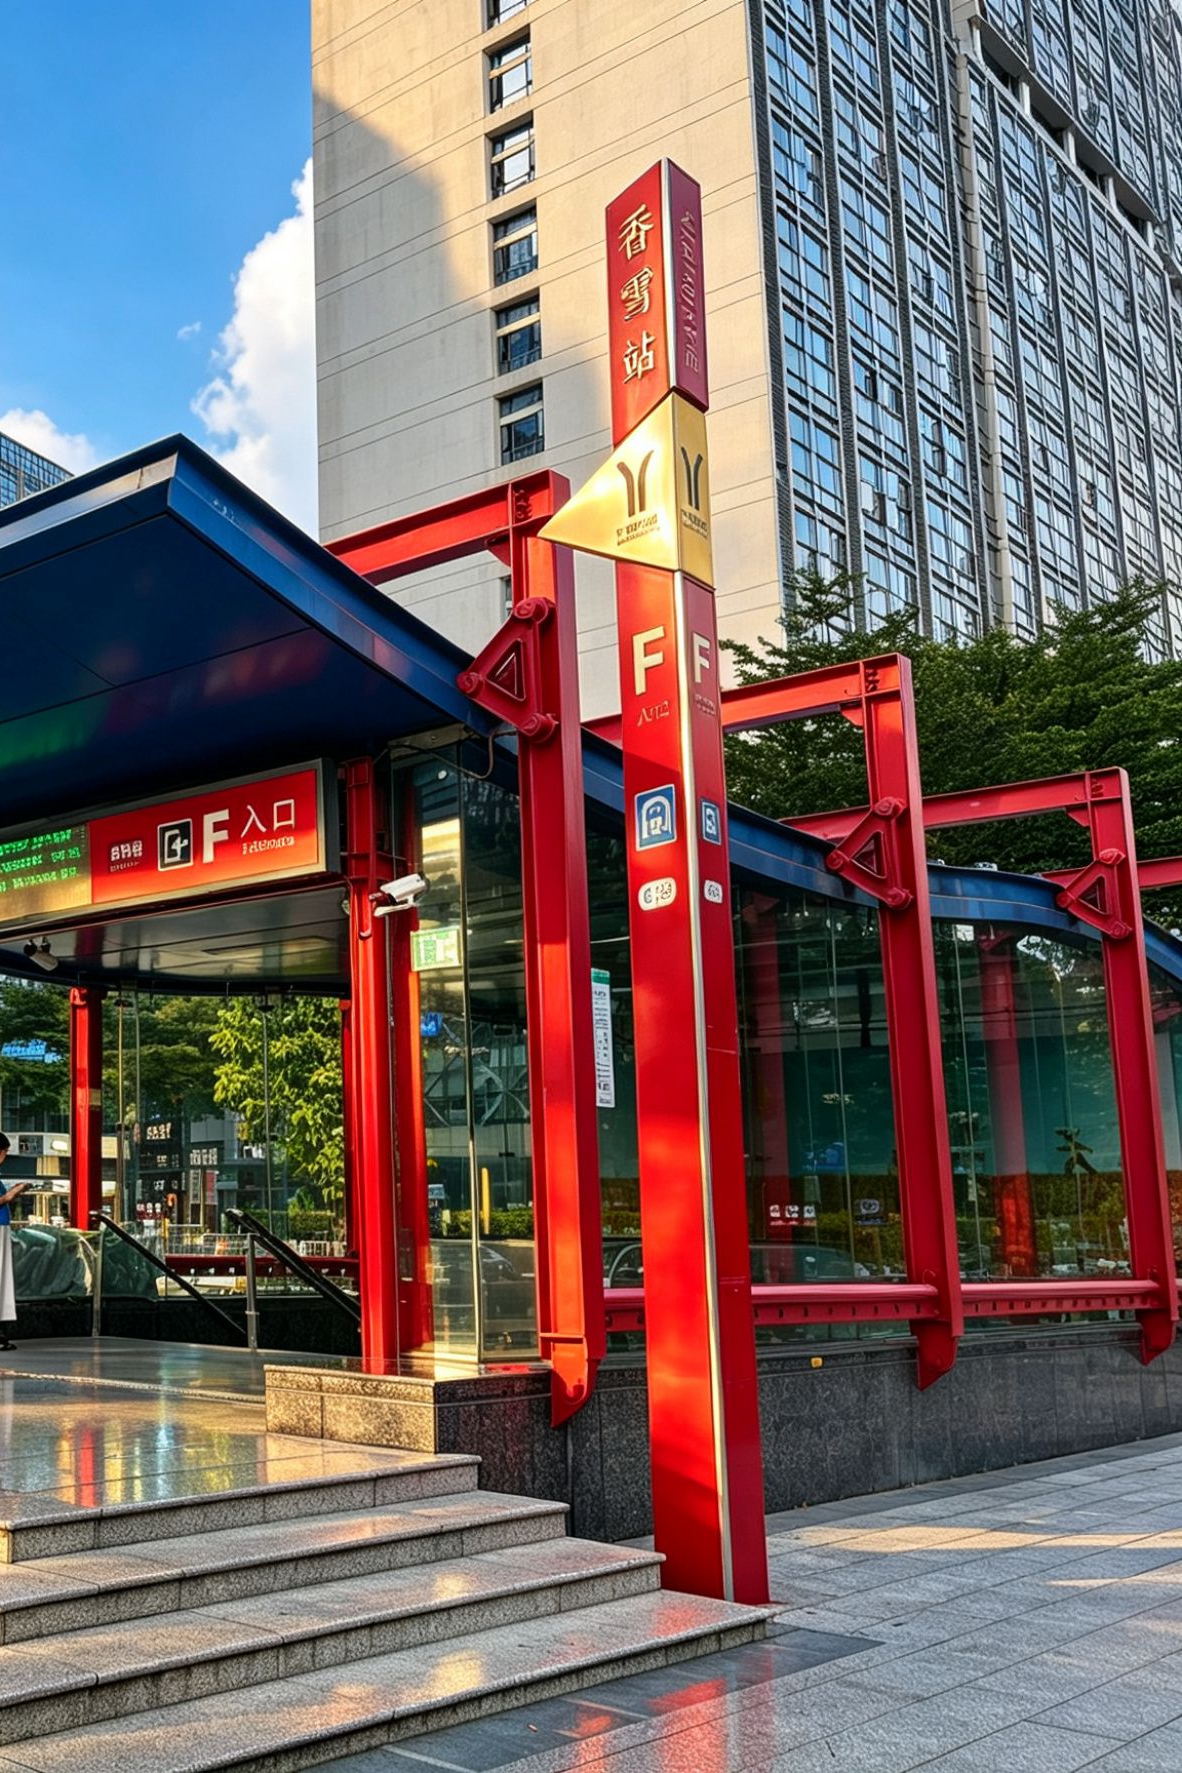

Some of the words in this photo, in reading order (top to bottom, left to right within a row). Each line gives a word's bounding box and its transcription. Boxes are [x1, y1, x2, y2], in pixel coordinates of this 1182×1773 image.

[633, 626, 665, 696] F
[693, 633, 711, 683] F
[203, 809, 230, 864] F
[240, 799, 295, 838] 入口
